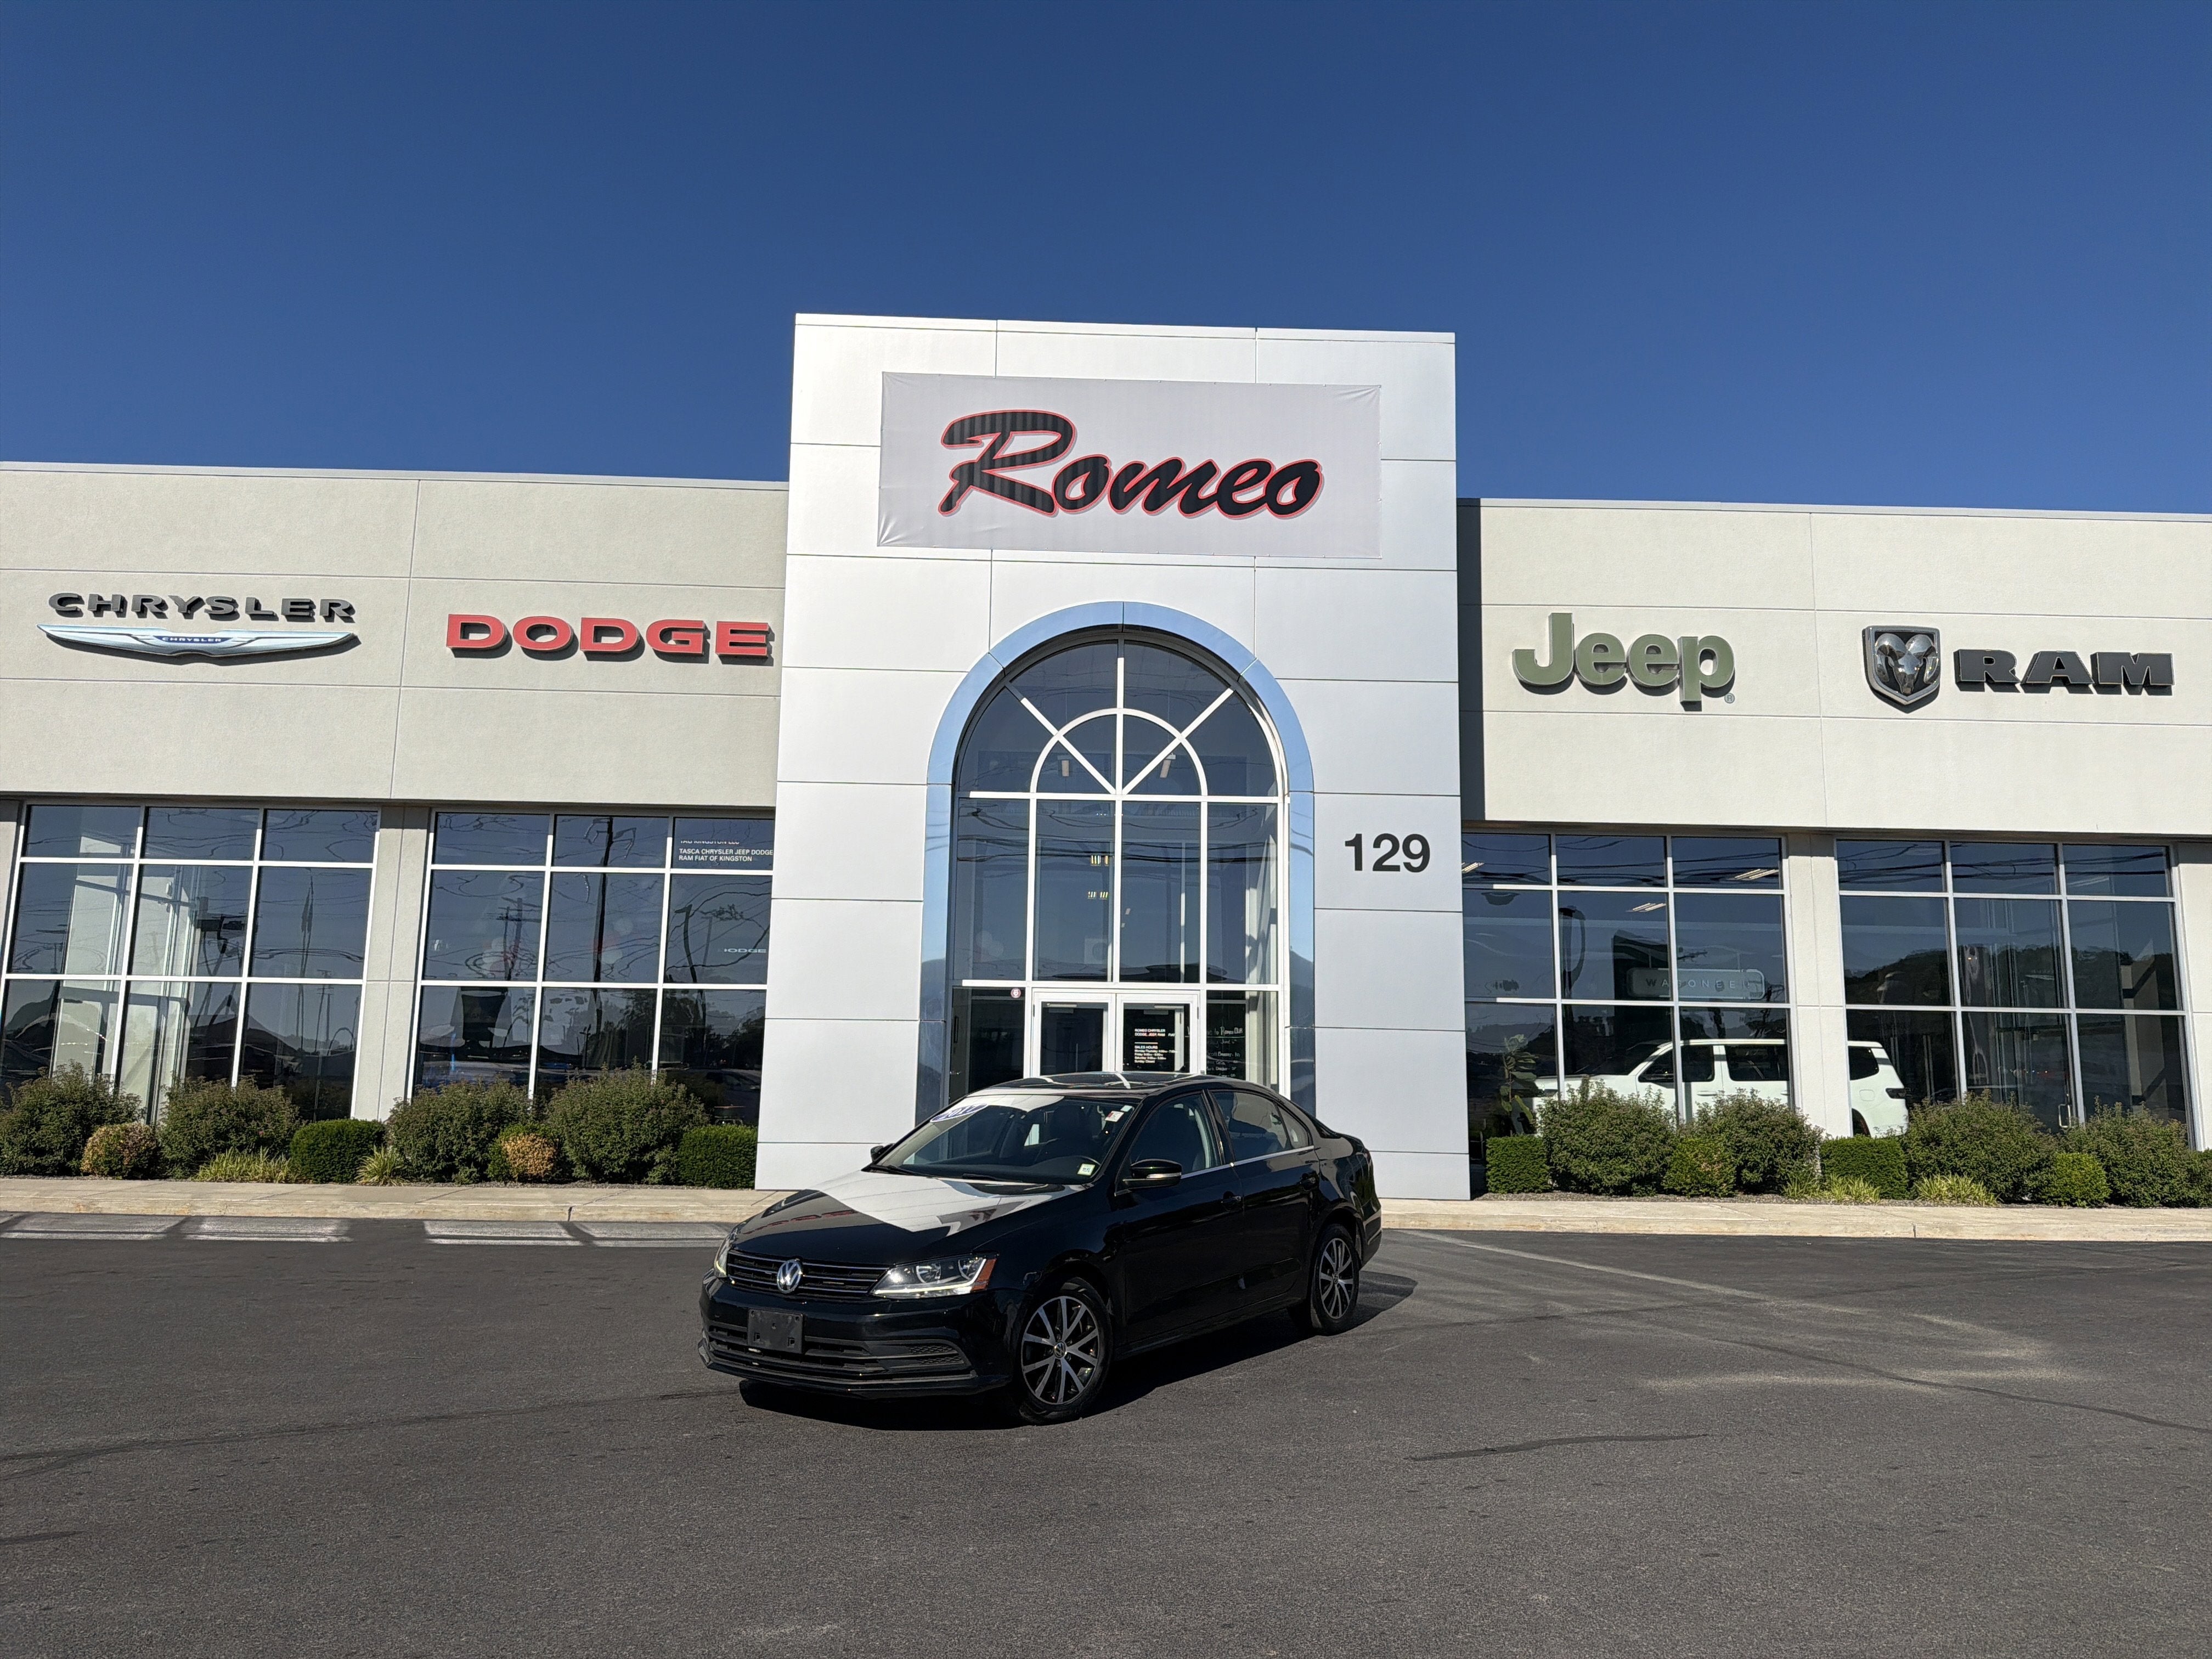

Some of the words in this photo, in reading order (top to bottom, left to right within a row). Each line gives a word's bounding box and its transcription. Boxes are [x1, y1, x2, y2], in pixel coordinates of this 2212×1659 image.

[938, 409, 1323, 518] Romeo
[48, 592, 356, 623] CHRYSLER
[446, 613, 770, 658] DODGE
[1512, 612, 1735, 703] Jeep
[1954, 649, 2175, 689] RAM
[1345, 833, 1430, 873] 129
